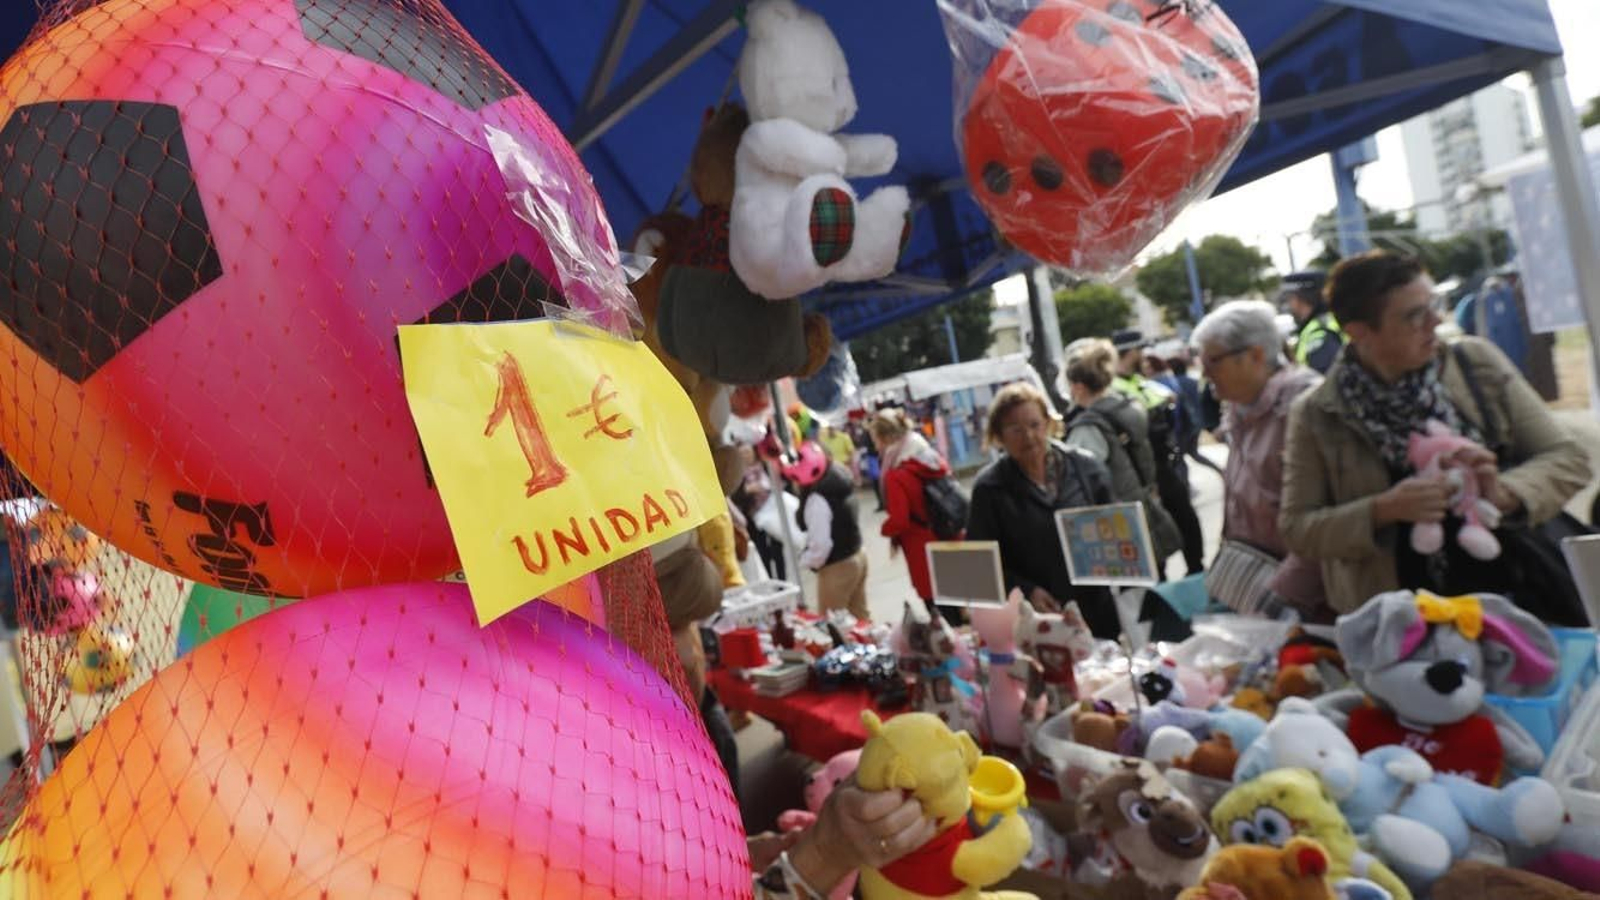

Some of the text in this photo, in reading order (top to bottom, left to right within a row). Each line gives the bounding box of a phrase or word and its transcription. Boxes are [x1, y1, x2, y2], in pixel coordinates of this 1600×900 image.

[484, 350, 634, 499] 1 €
[511, 488, 691, 577] UNIDAD
